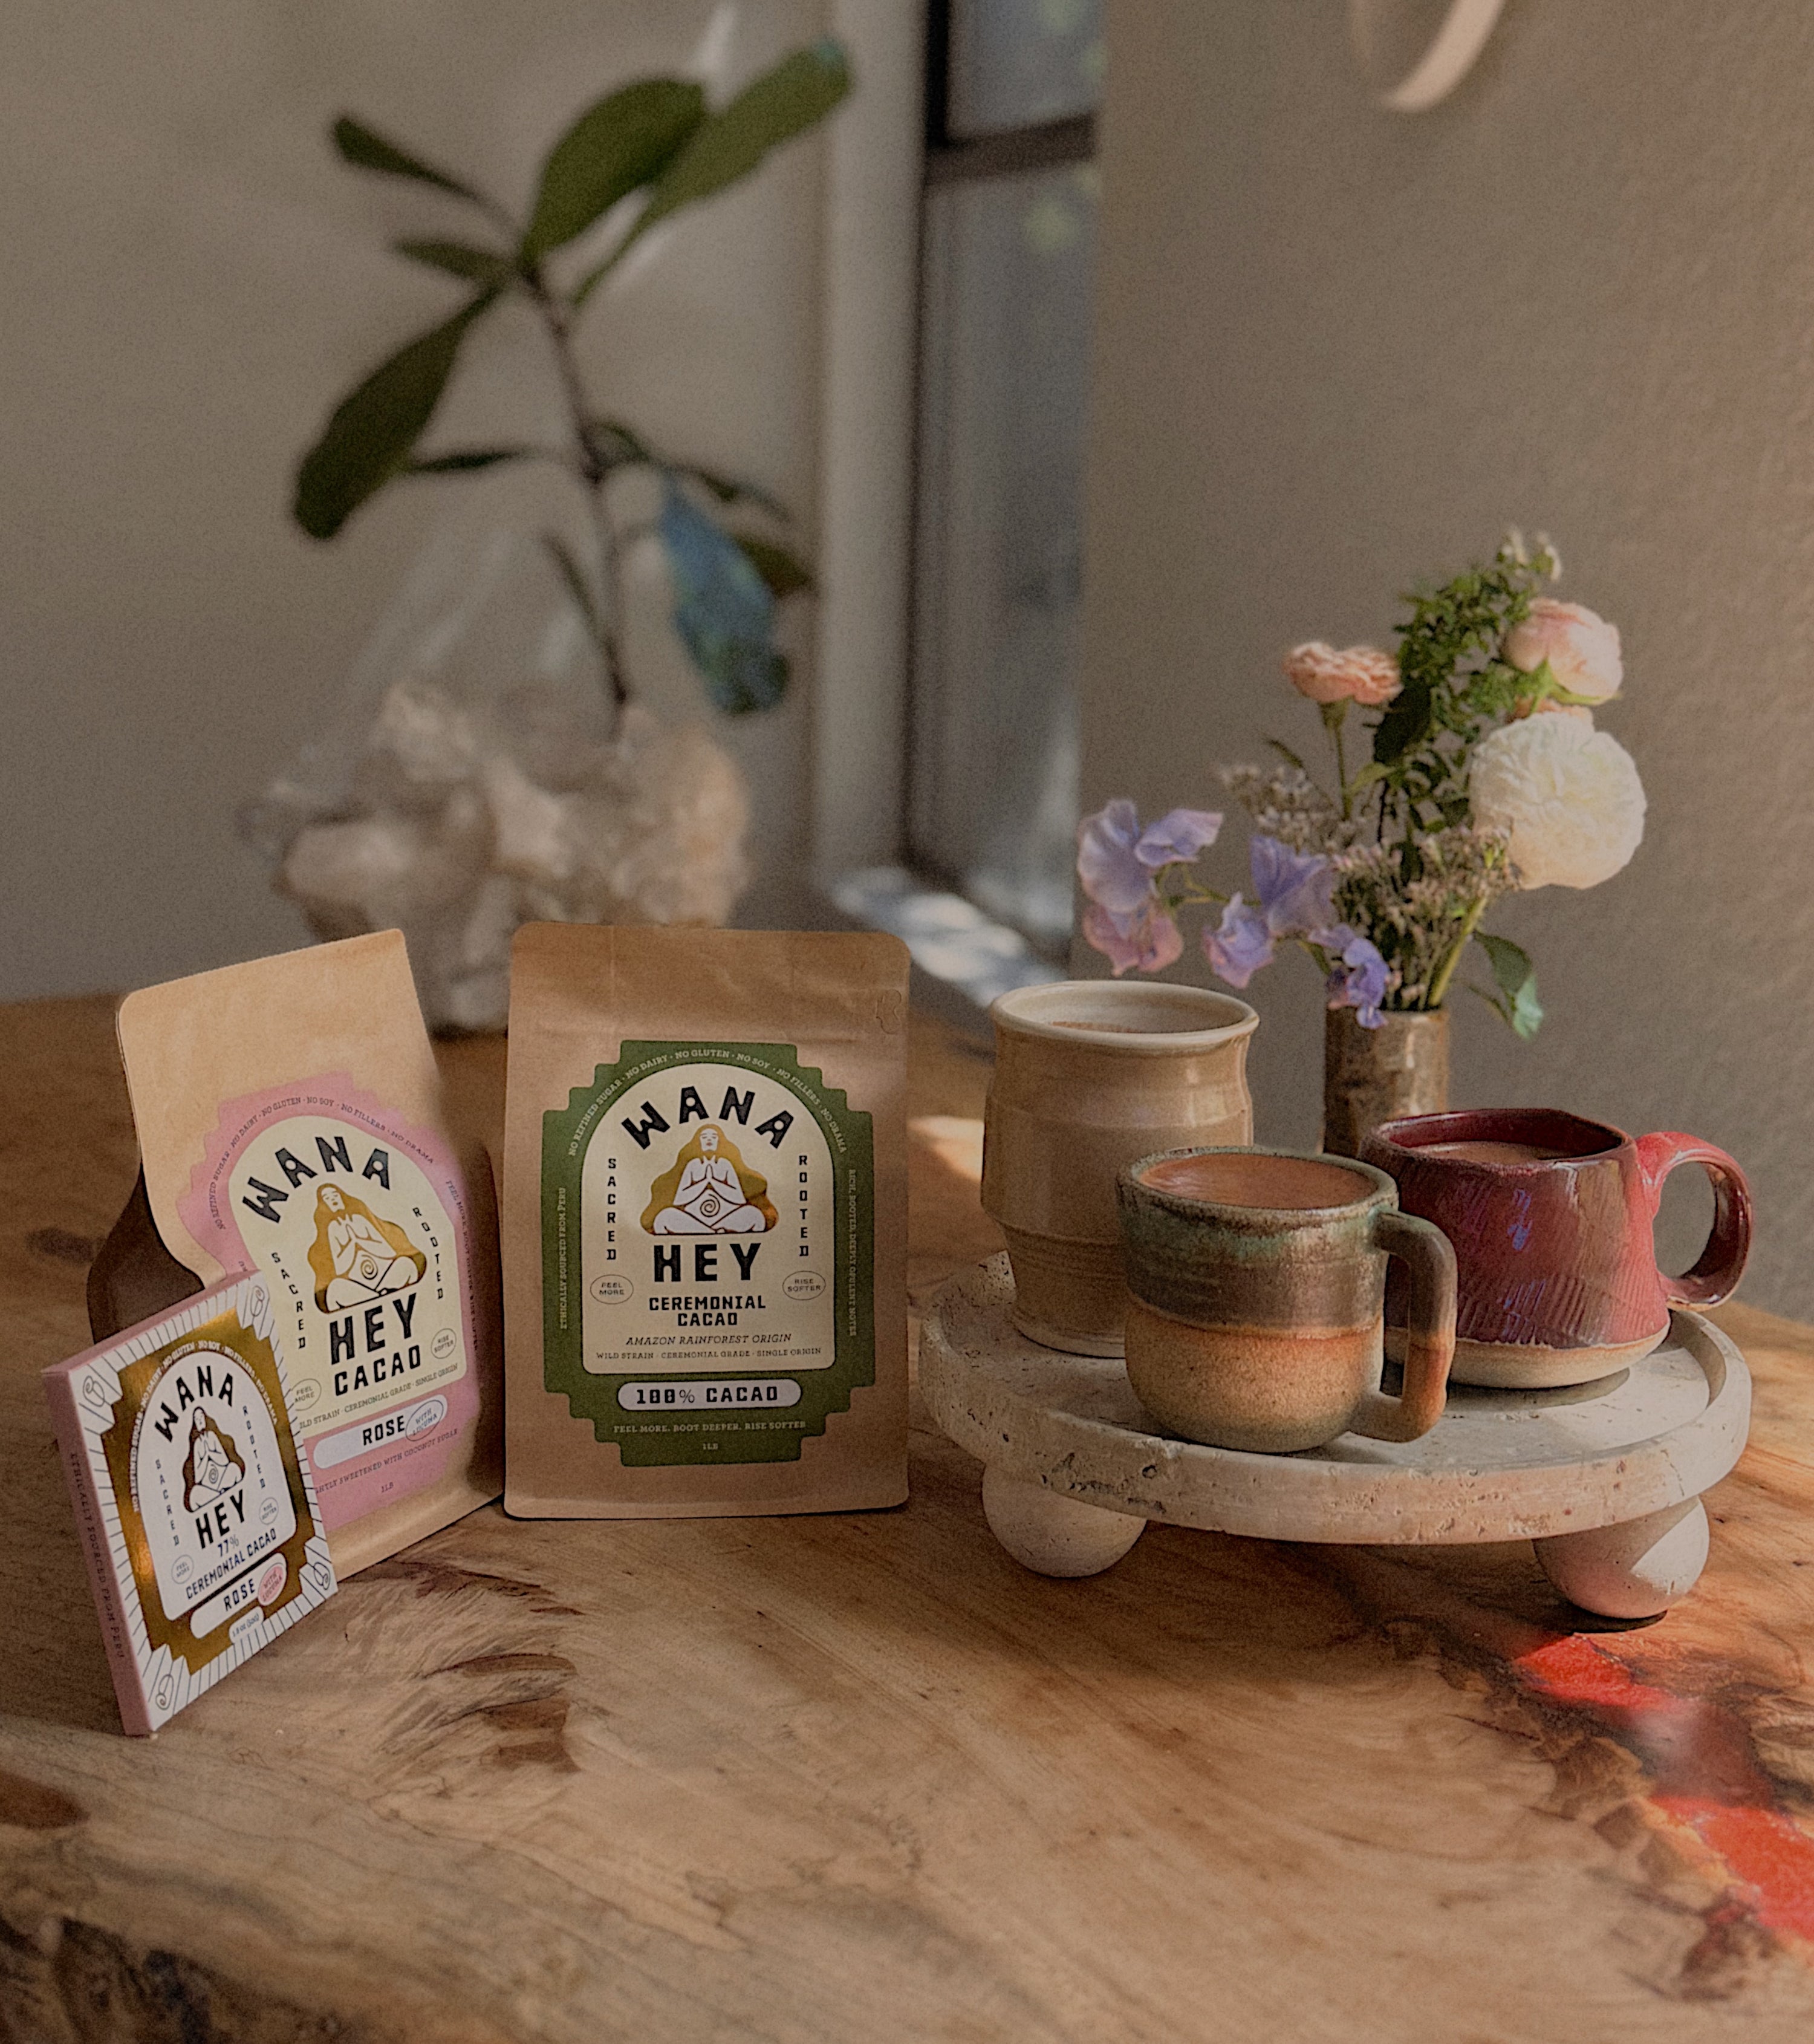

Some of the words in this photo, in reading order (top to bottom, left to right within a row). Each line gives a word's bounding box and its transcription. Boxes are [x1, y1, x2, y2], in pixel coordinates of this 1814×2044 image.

[261, 1106, 272, 1117] NO
[273, 1097, 301, 1110] GLUTEN
[320, 1098, 334, 1107] SOY
[341, 1103, 353, 1113] NO
[569, 1141, 577, 1156] NO
[576, 1104, 599, 1142] REFINED
[597, 1078, 622, 1105] SUGAR
[625, 1067, 639, 1079] NO
[640, 1055, 668, 1070] DAIRY
[675, 1050, 689, 1059] NO
[691, 1049, 730, 1058] GLUTEN
[736, 1053, 750, 1063] NO
[752, 1058, 771, 1069] SOY
[776, 1069, 790, 1079] NO
[791, 1076, 821, 1105] FILLERS
[821, 1108, 833, 1121] NO
[829, 1121, 847, 1153] DRAMA
[239, 1115, 259, 1137] DAIRY
[354, 1109, 386, 1131] FILLERS
[621, 1086, 794, 1149] WANA
[230, 1135, 240, 1148] NO
[391, 1131, 404, 1142] NO
[405, 1139, 434, 1164] DRAMA
[213, 1151, 230, 1181] SUGAR
[242, 1136, 390, 1223] WANA
[209, 1182, 219, 1219] REFINED
[558, 1187, 566, 1211] PERU
[606, 1158, 616, 1260] SACRED
[799, 1155, 809, 1257] ROOTED
[215, 1219, 226, 1230] NO
[412, 1207, 444, 1300] ROOTED
[654, 1243, 761, 1282] HEY
[787, 1284, 821, 1293] SOFTER
[271, 1252, 305, 1350] SACRED
[649, 1295, 766, 1310] CEREMONIAL
[330, 1292, 417, 1365] HEY
[677, 1312, 738, 1326] CACAO
[434, 1340, 454, 1353] SOFTER
[438, 1335, 449, 1344] RISE
[626, 1336, 675, 1346] AMAZON
[679, 1335, 749, 1344] RAINFOREST
[752, 1333, 792, 1343] ORIGIN
[596, 1352, 619, 1360] WILD
[790, 1347, 822, 1356] ORIGIN
[334, 1345, 421, 1396] CACAO
[295, 1391, 314, 1402] MORE
[296, 1386, 313, 1396] FEEL
[313, 1409, 340, 1424] STRAIN
[345, 1391, 389, 1413] CEREMONIAL
[389, 1382, 412, 1397] GRADE
[415, 1373, 438, 1387] SINGLE
[437, 1363, 458, 1378] ORIGIN
[636, 1388, 695, 1404] 100%
[706, 1386, 778, 1402] CACAO
[154, 1365, 233, 1443] WANA
[416, 1408, 431, 1424] WITH
[363, 1415, 405, 1446] ROSE
[769, 1421, 806, 1430] SOFTER
[243, 1405, 265, 1488] ROOTED
[339, 1462, 382, 1484] SWEETENED
[384, 1452, 402, 1465] WITH
[405, 1439, 436, 1457] COCONUT
[437, 1428, 458, 1442] SUGAR
[155, 1459, 180, 1546] SACRED
[196, 1489, 245, 1549] HEY
[71, 1453, 92, 1523] ETHICALLY
[88, 1526, 106, 1583] SOURCED
[103, 1589, 115, 1622] FROM
[110, 1626, 125, 1658] PERU
[218, 1534, 239, 1558] 77%
[186, 1551, 245, 1600] CEREMONIAL
[247, 1528, 276, 1557] CACAO
[224, 1578, 255, 1612] ROSE
